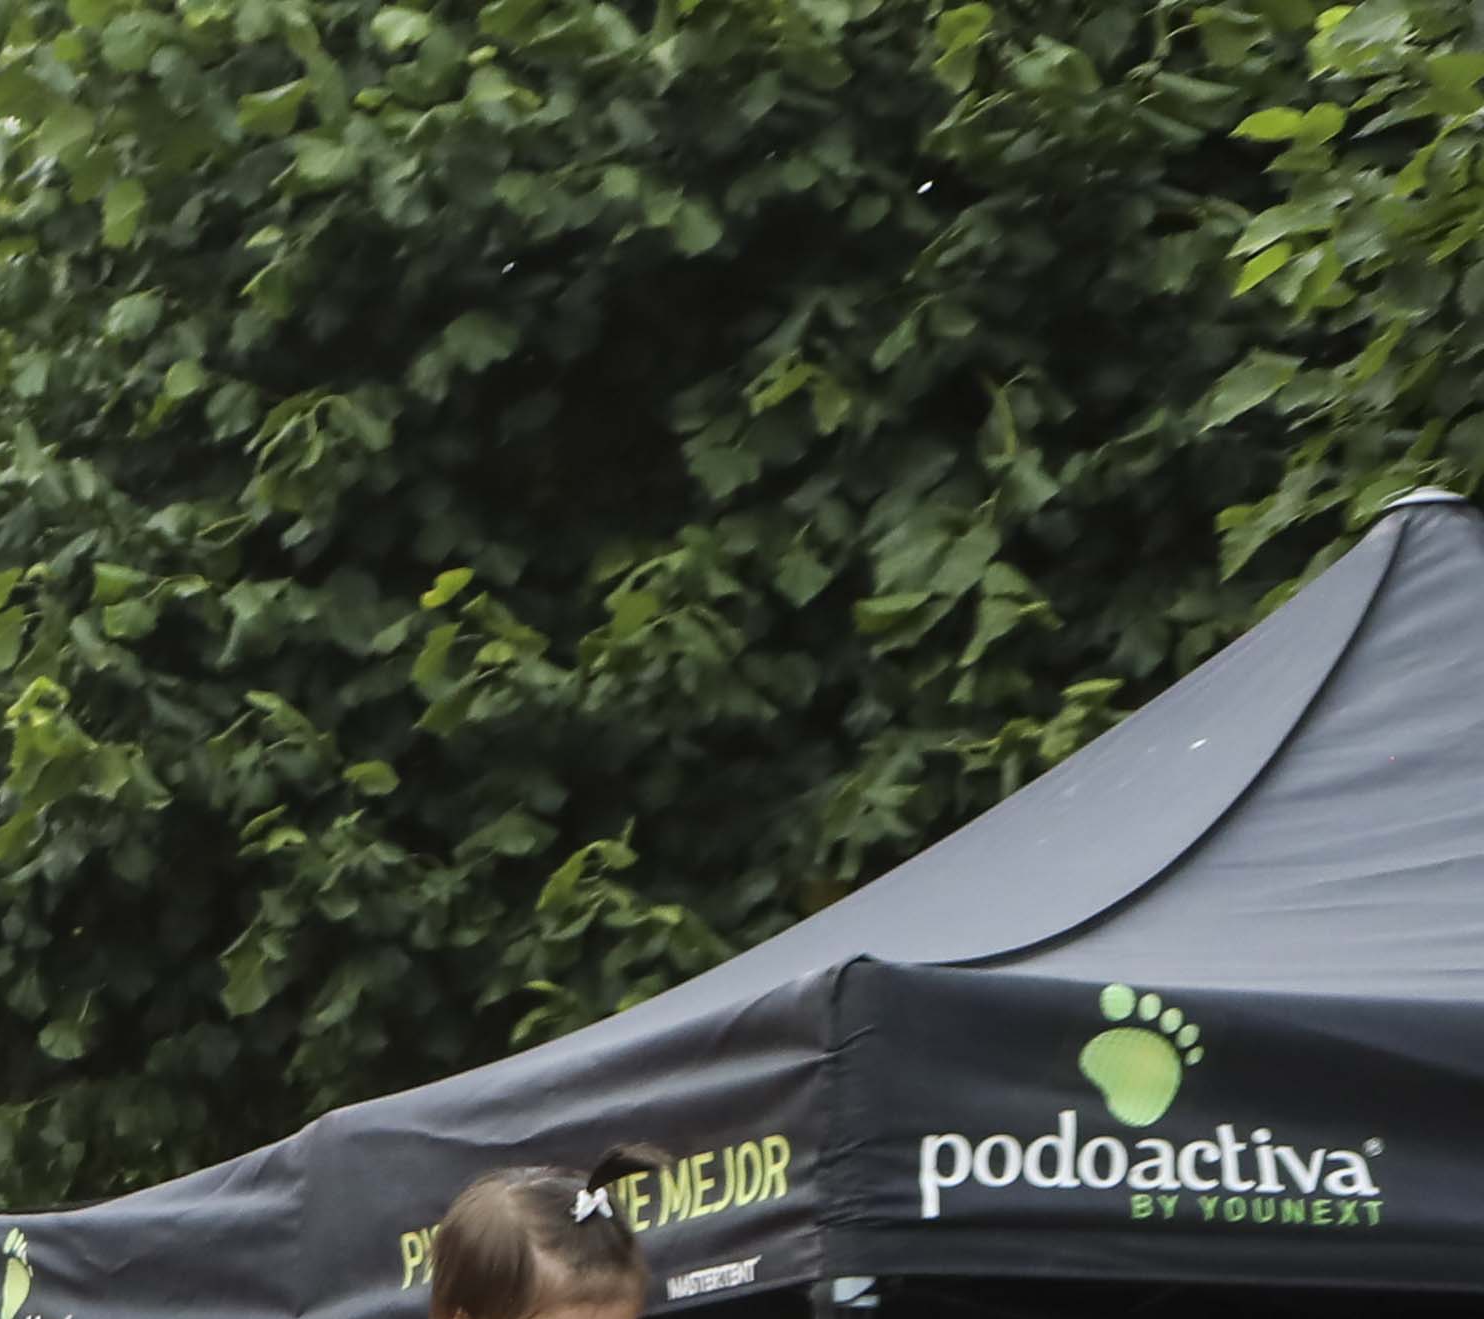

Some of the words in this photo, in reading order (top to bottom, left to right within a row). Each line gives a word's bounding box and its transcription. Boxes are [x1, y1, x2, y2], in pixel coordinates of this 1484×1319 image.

[658, 1134, 791, 1228] MEJOR
[919, 1110, 1380, 1220] podoactiva
[1130, 1193, 1178, 1221] BY
[1197, 1196, 1384, 1228] YOUNEXT
